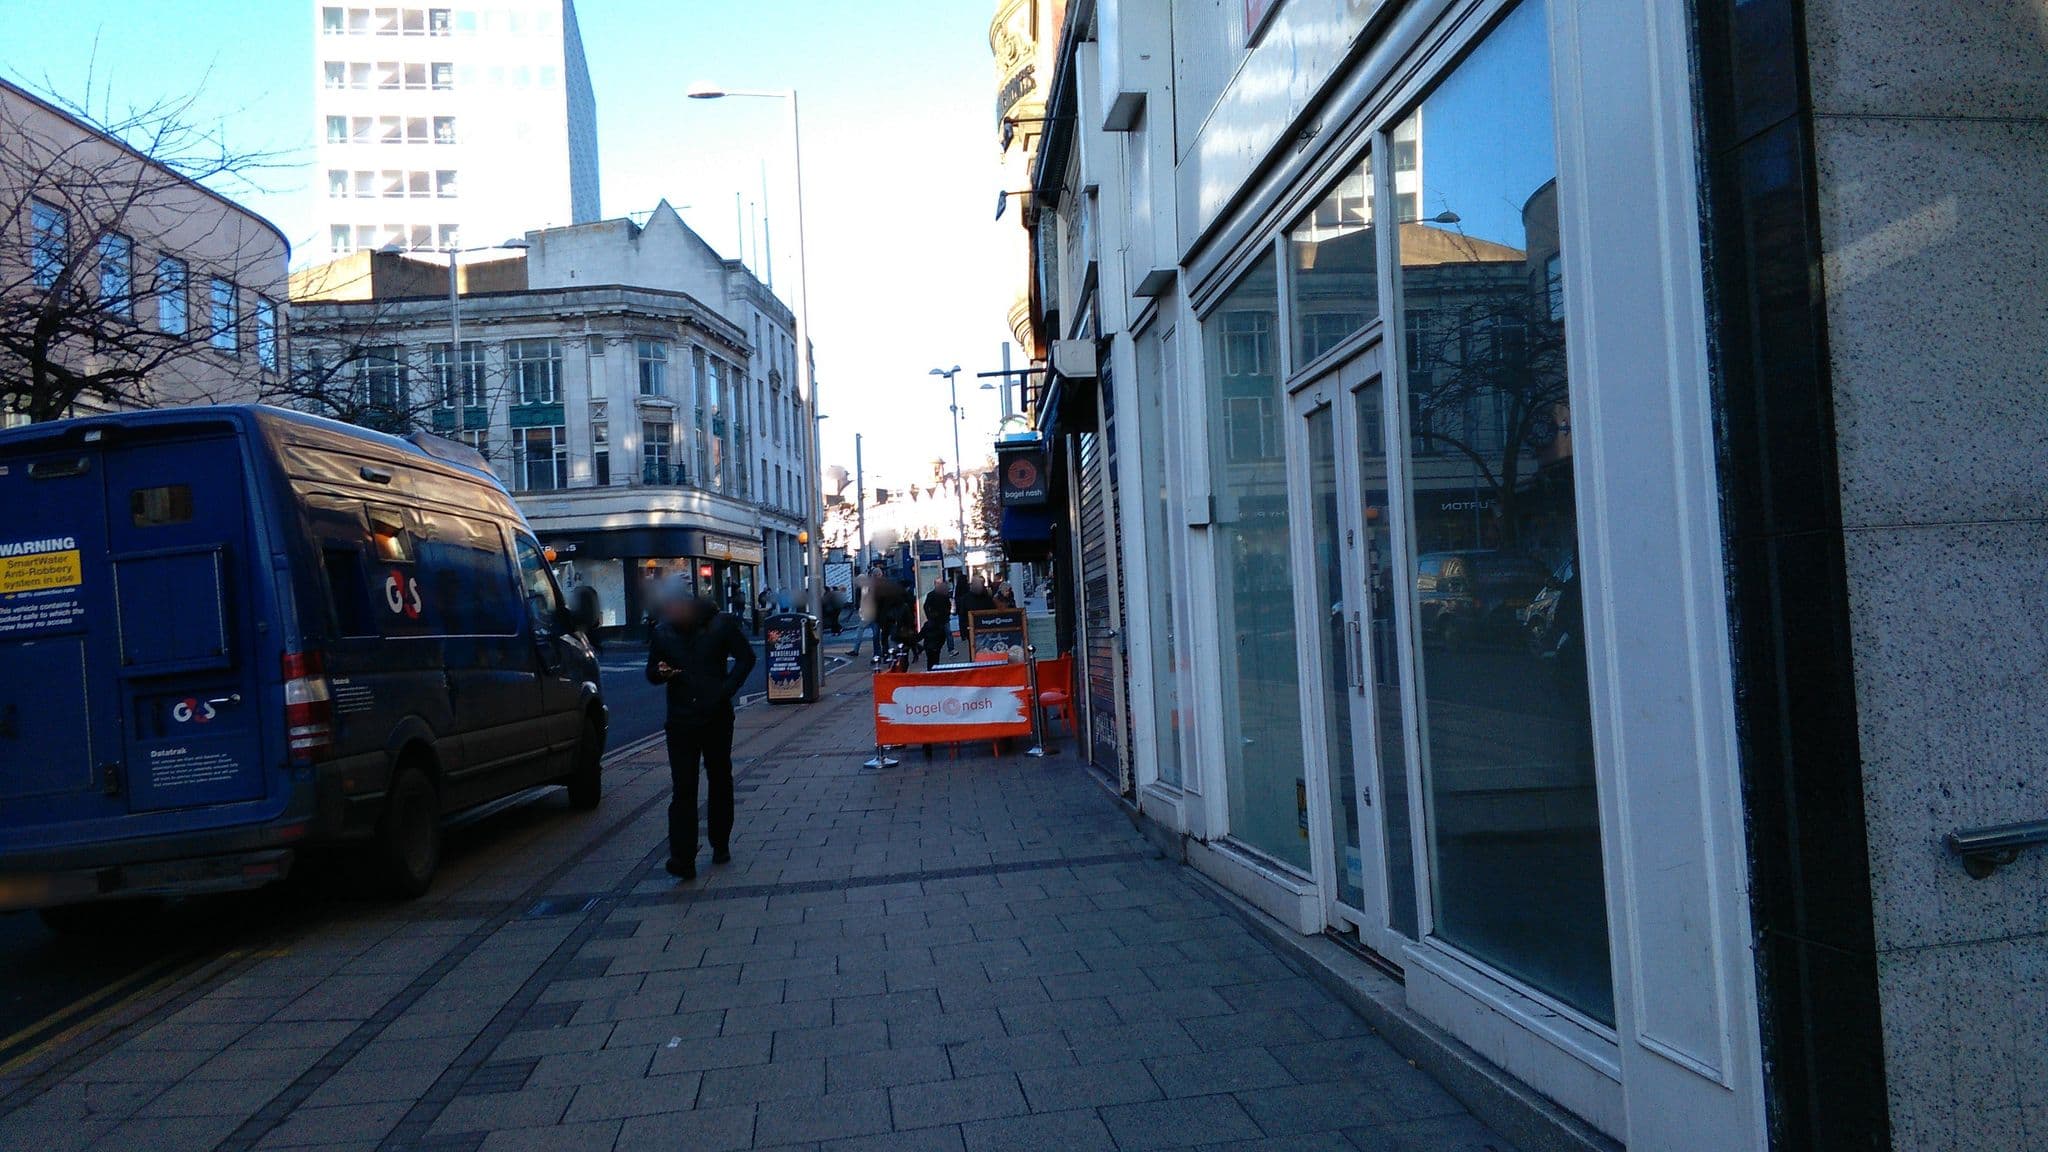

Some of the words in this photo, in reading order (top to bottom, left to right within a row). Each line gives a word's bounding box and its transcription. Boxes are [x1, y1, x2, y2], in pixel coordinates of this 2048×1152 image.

[1005, 490, 1024, 499] bagel
[1025, 489, 1042, 497] nash
[0, 537, 75, 556] WARNING
[7, 555, 69, 569] SmartWater
[4, 565, 73, 579] Anti-Robbery
[4, 578, 41, 590] system
[55, 575, 74, 584] use
[385, 569, 422, 619] G4S
[12, 604, 39, 613] vehicle
[39, 601, 71, 611] contains
[0, 614, 22, 623] ocked
[22, 612, 39, 620] safe
[39, 611, 48, 619] to
[49, 609, 71, 618] which
[16, 622, 34, 630] have
[34, 620, 46, 628] no
[46, 618, 73, 627] access
[173, 698, 216, 722] G4S
[905, 702, 941, 717] bagel
[962, 698, 993, 712] nash
[150, 747, 187, 758] Datatrak
